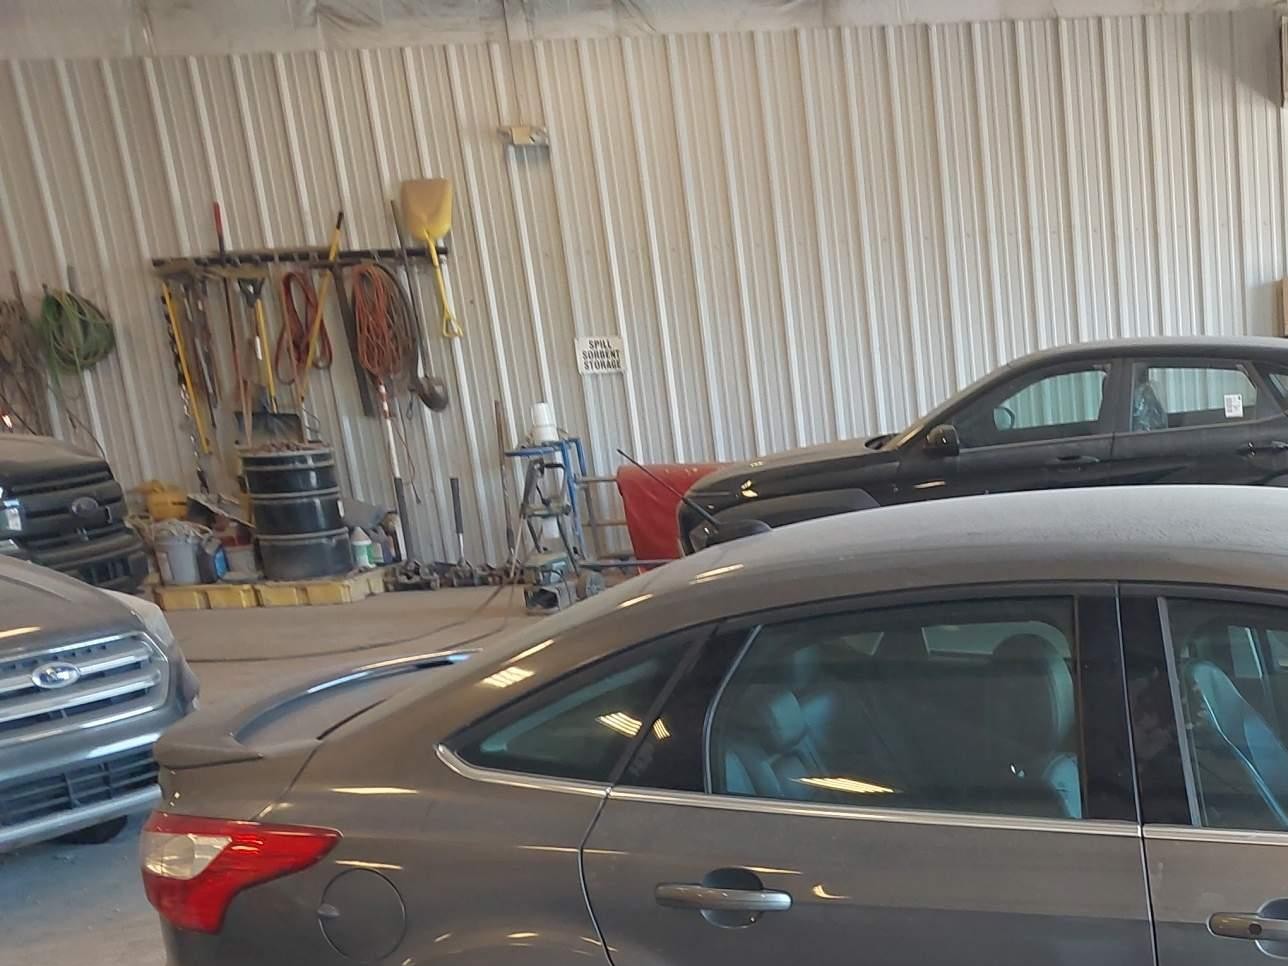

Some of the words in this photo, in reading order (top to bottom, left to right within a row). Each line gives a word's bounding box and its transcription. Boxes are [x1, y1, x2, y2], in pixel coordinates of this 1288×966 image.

[588, 339, 612, 349] SPILL
[582, 349, 621, 360] SORBENT
[583, 360, 621, 370] STORAGE
